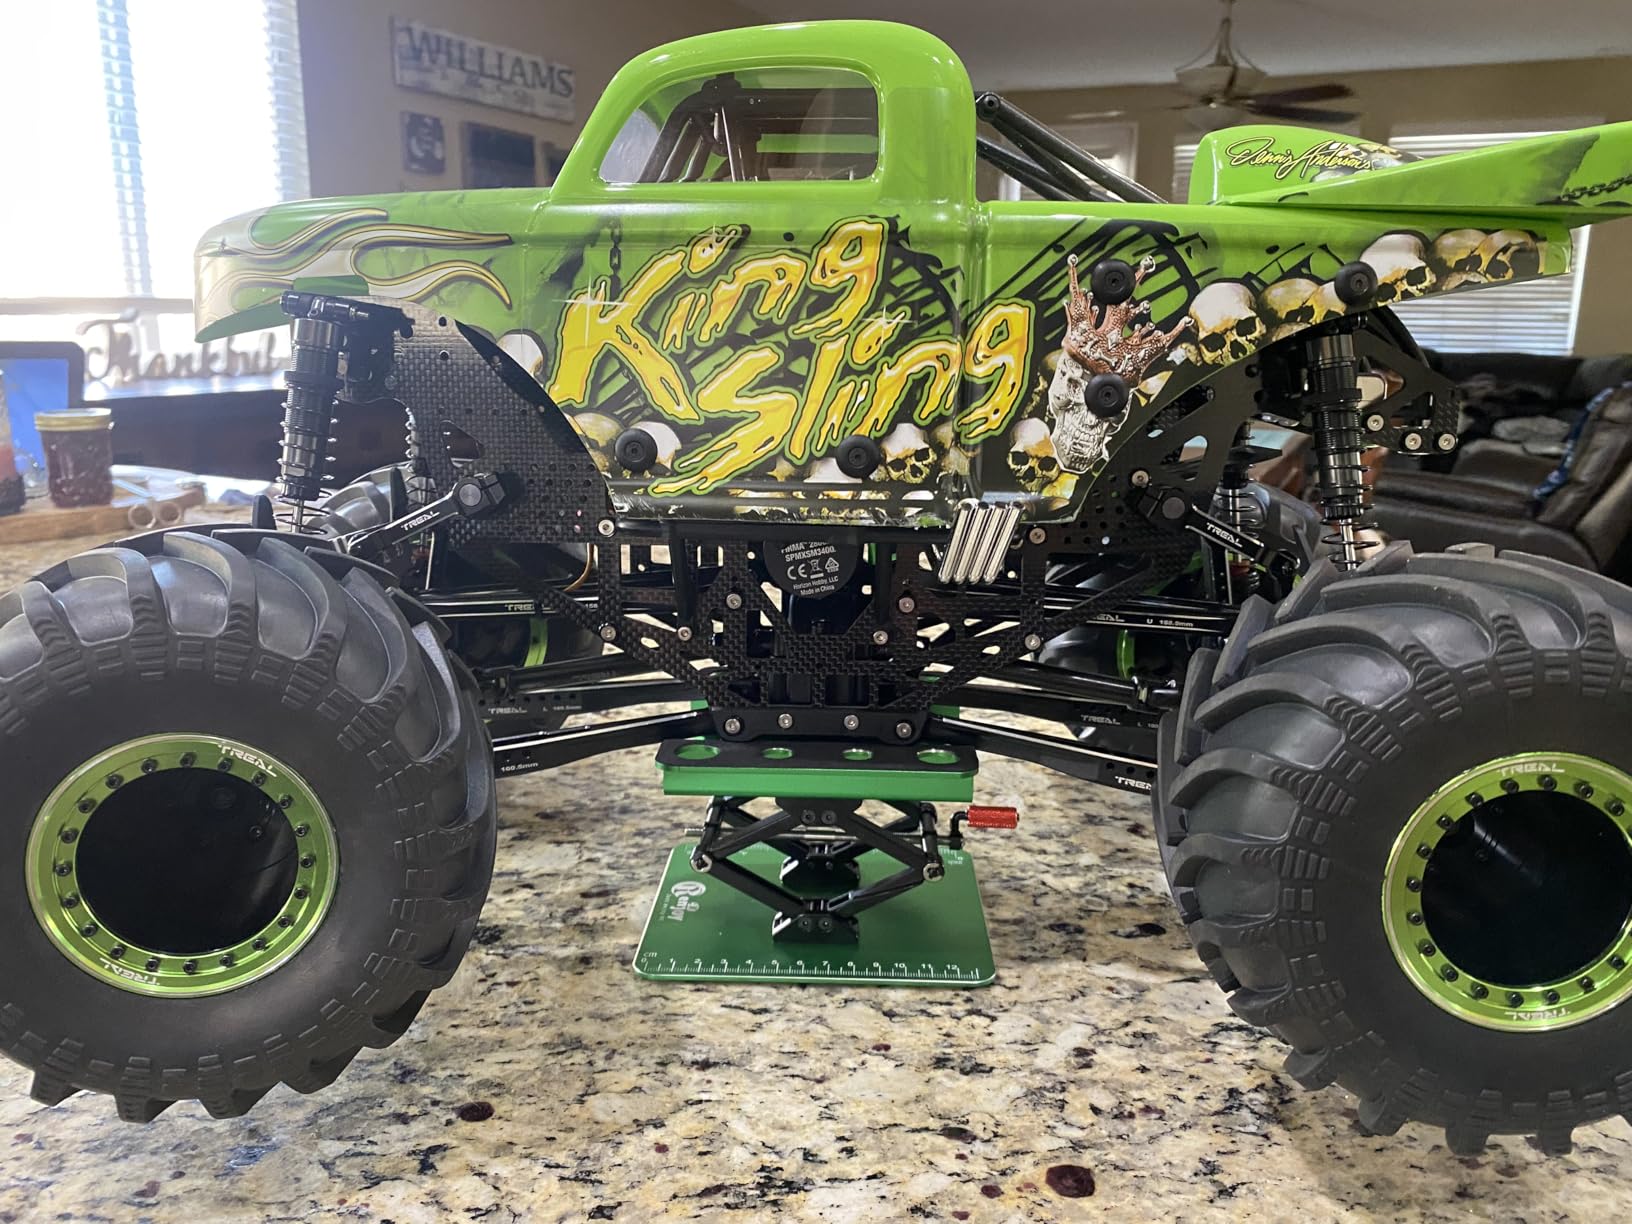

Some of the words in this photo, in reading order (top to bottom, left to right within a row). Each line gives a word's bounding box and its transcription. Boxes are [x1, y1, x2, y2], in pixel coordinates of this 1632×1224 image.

[400, 26, 573, 98] WILLIAMS
[549, 217, 887, 422] King
[650, 302, 1031, 494] Sling
[401, 511, 440, 531] TREAL
[1206, 522, 1243, 548] TREAL
[793, 582, 812, 590] Horizon
[488, 706, 528, 714] TREAL
[1080, 714, 1121, 725] TREAL
[217, 743, 278, 778] TREAL
[1496, 762, 1566, 777] TREAL
[99, 957, 160, 986] TREAL
[1504, 1007, 1571, 1021] TREAL
